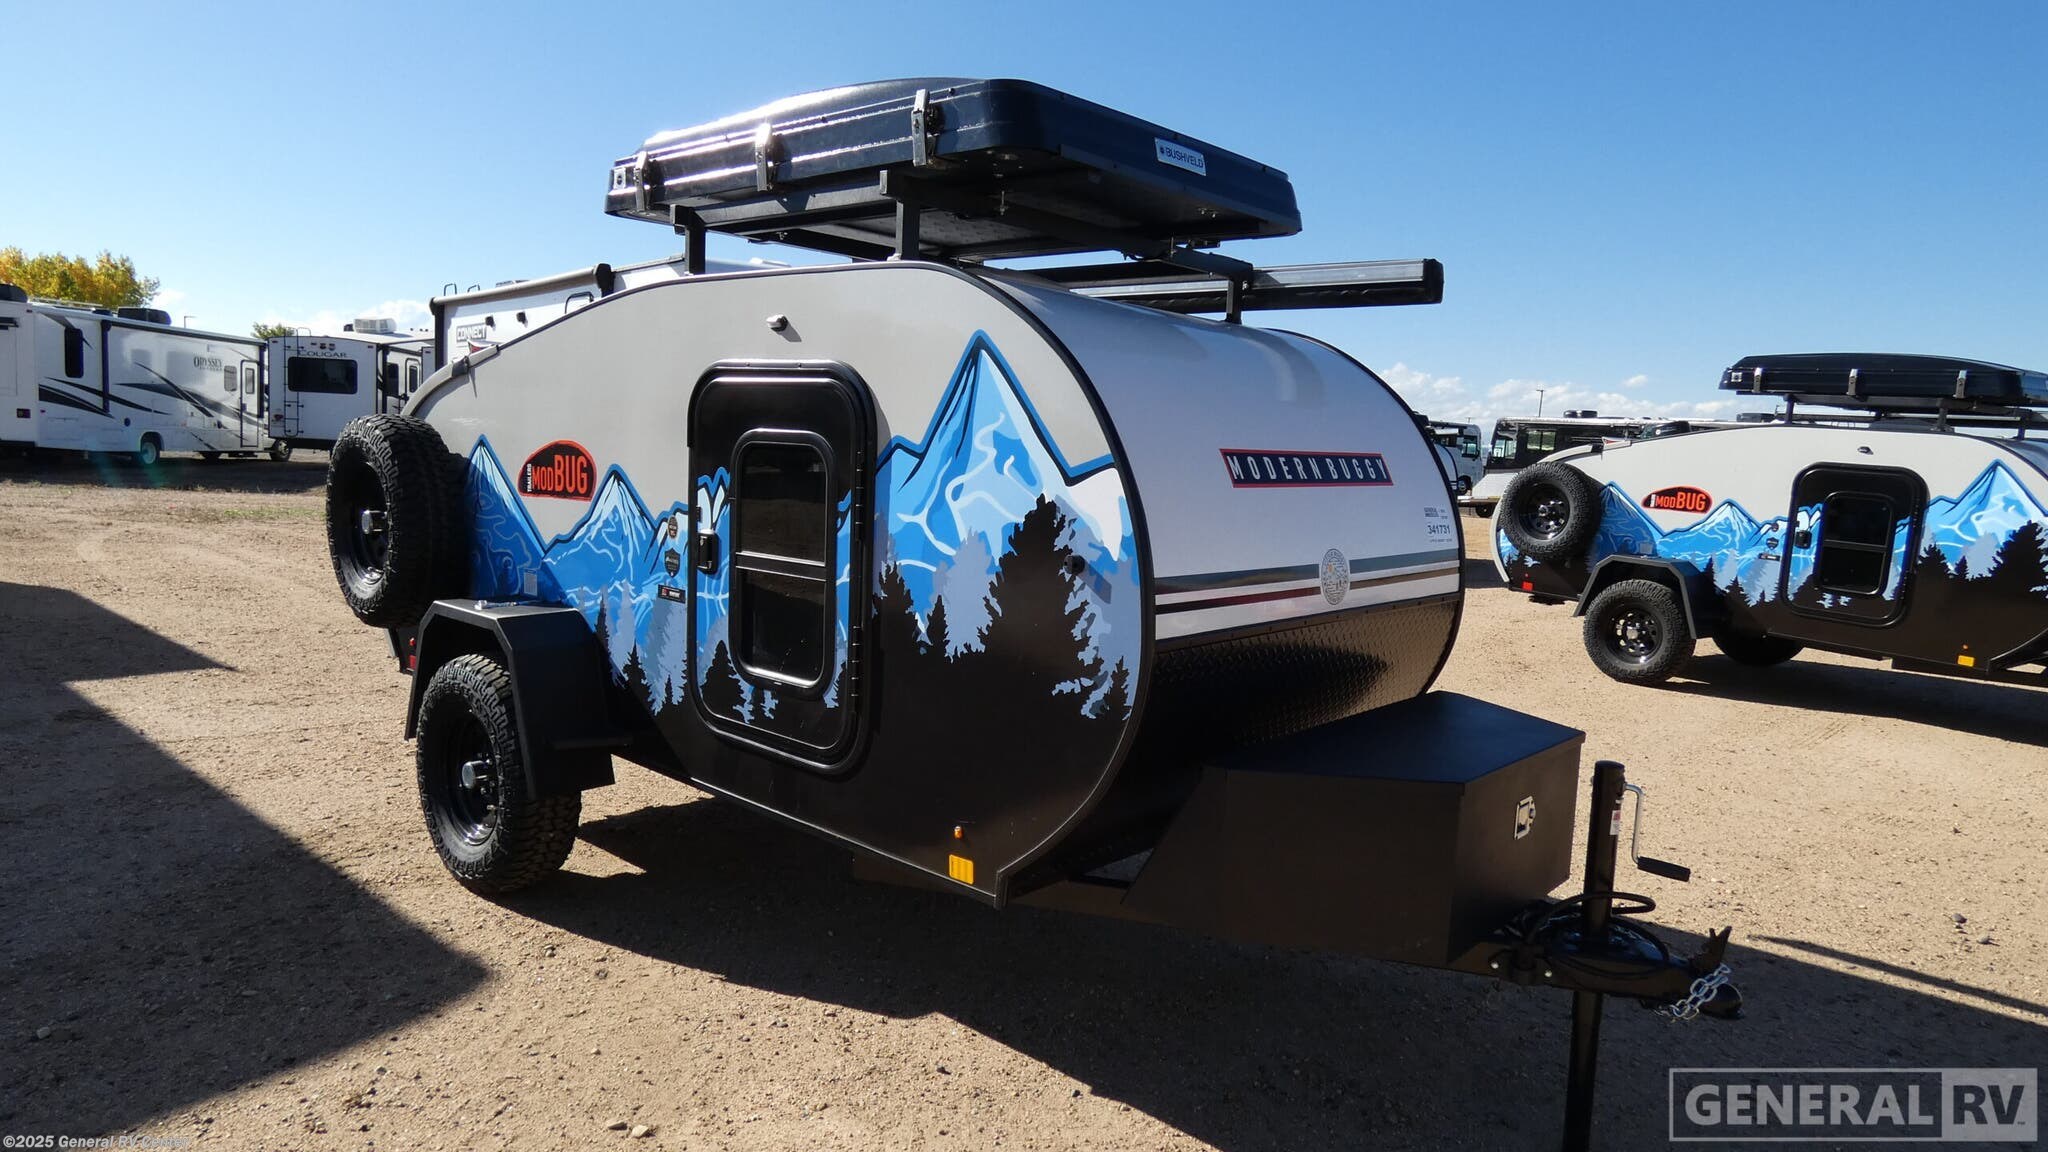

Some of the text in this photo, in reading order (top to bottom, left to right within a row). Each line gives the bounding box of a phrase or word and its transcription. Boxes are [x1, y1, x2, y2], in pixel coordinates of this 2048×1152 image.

[1165, 147, 1204, 168] BUSHVELD
[457, 327, 486, 341] CONNECT
[1226, 455, 1387, 480] MODERN BUGGY
[1427, 524, 1451, 535] 341731
